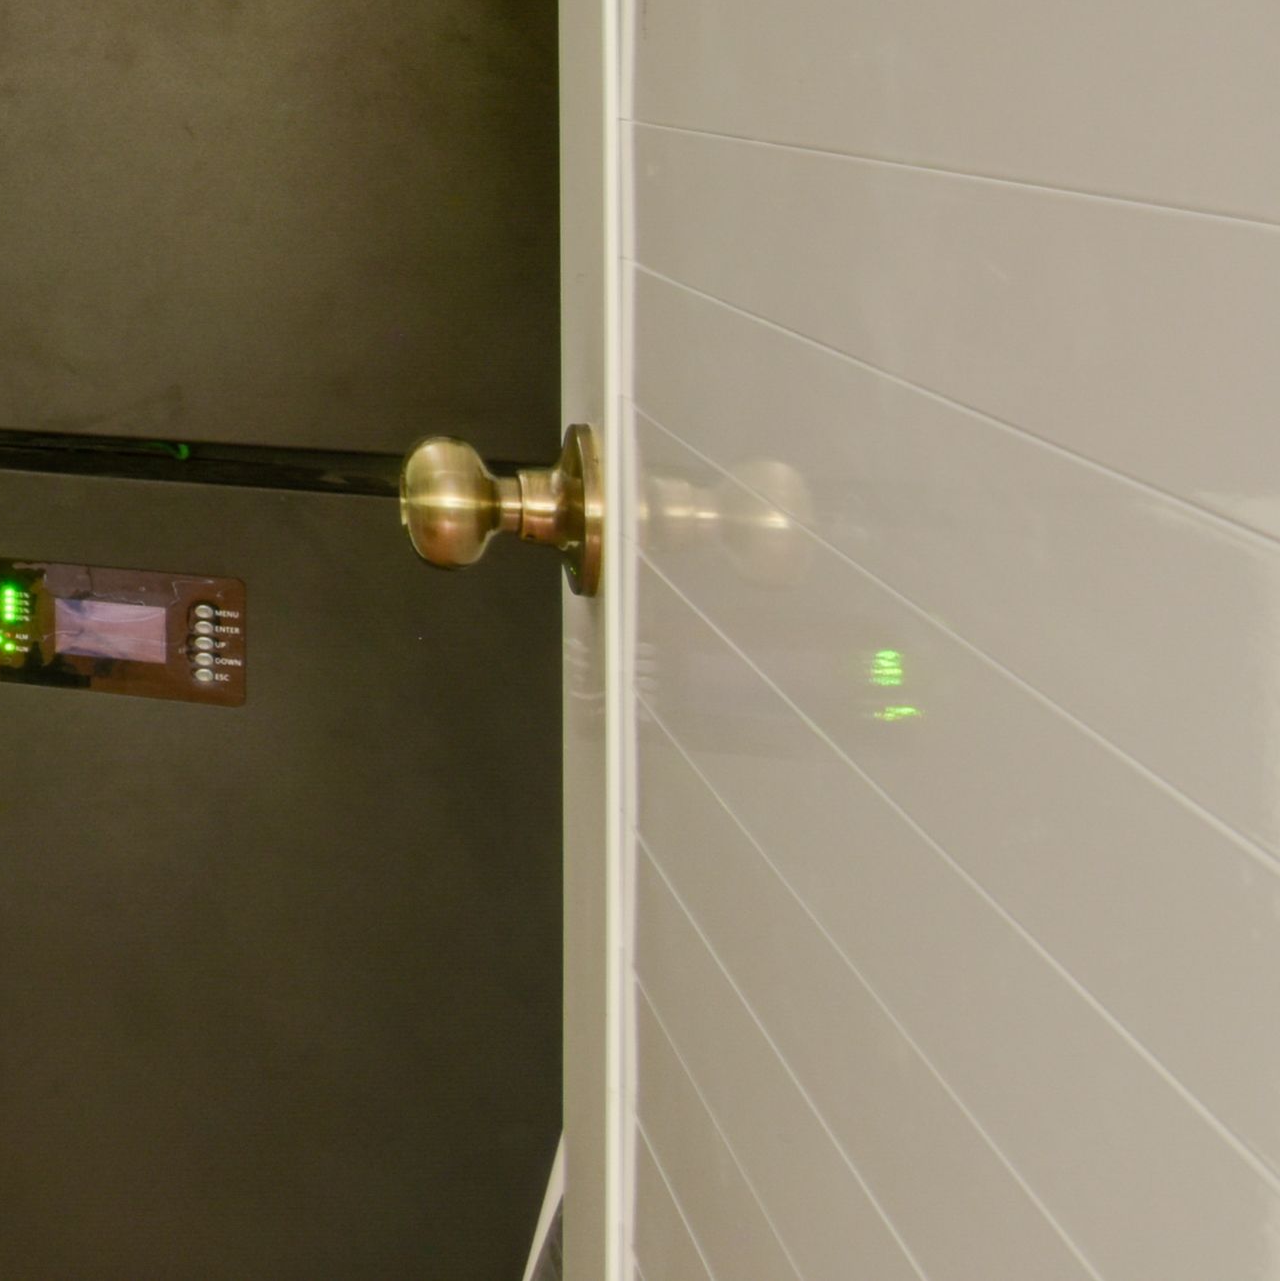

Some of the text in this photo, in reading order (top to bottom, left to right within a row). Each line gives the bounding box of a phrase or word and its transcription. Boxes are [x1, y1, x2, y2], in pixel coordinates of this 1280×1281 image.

[215, 610, 240, 619] MENU
[215, 626, 240, 634] ENTER
[215, 641, 227, 649] UP
[215, 658, 242, 667] DOWN
[215, 674, 230, 682] ESC
